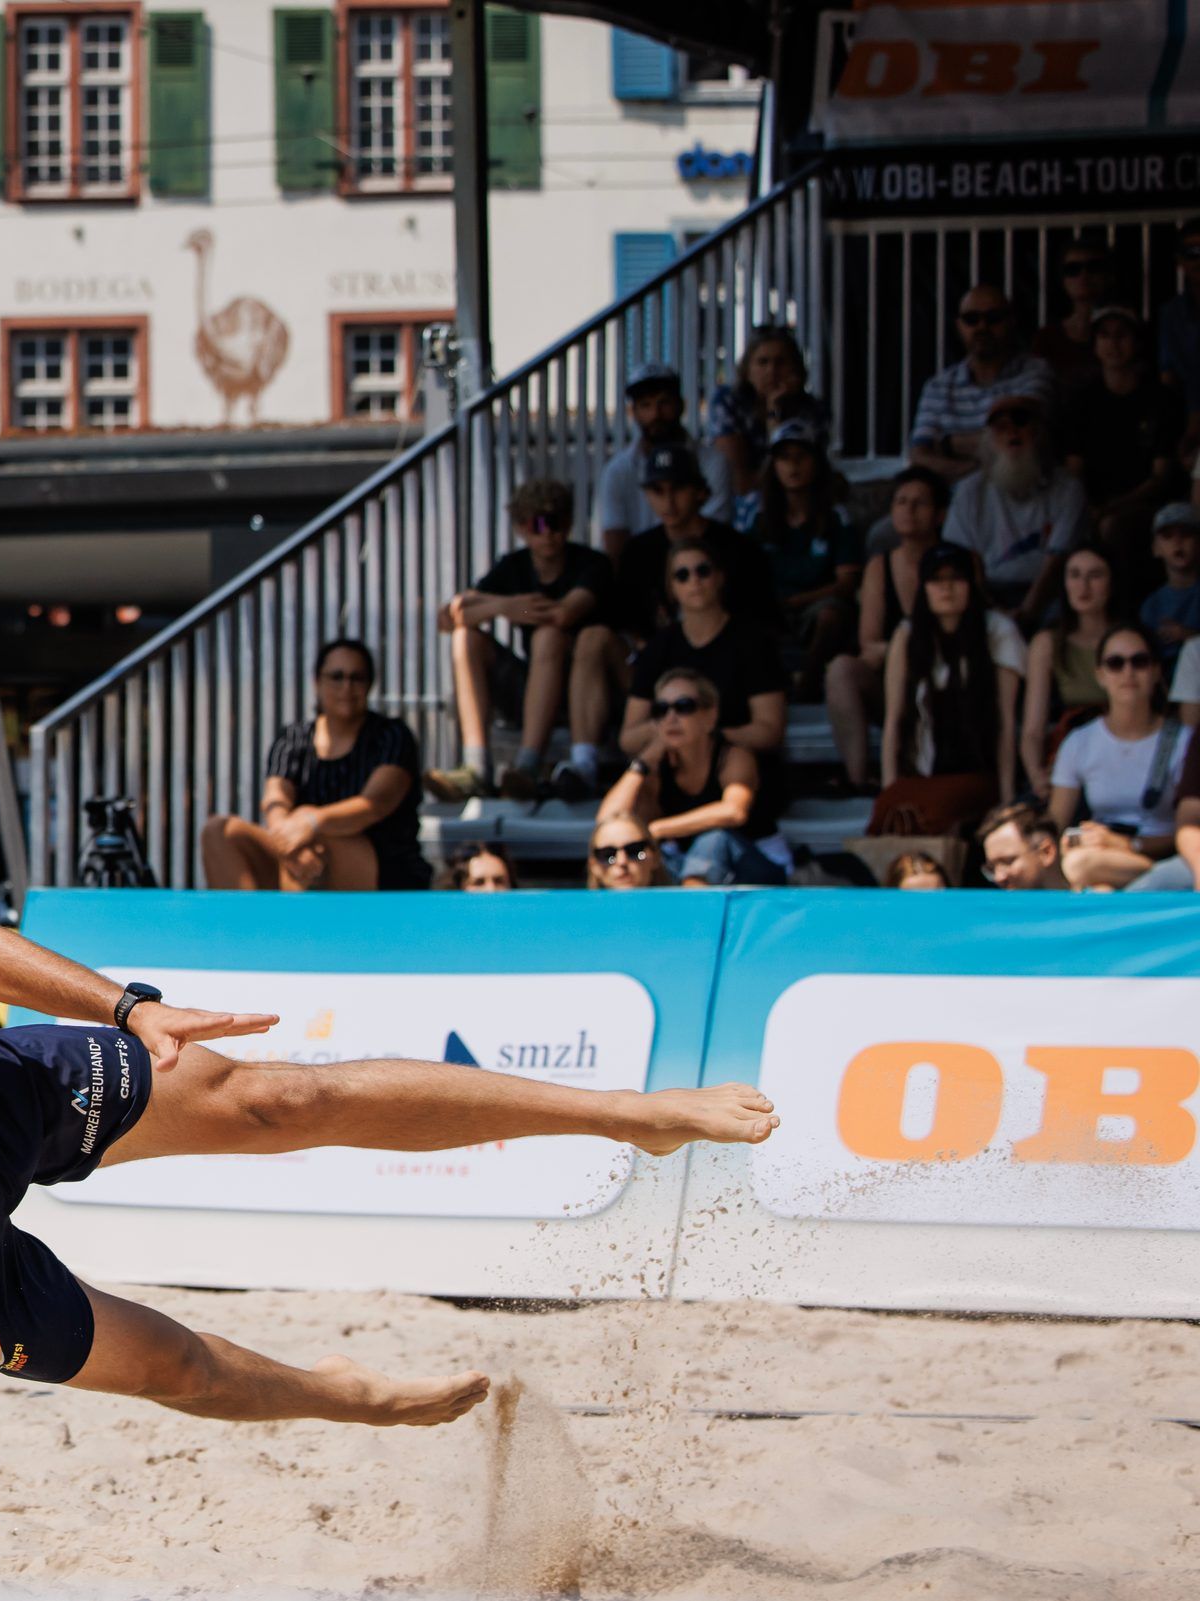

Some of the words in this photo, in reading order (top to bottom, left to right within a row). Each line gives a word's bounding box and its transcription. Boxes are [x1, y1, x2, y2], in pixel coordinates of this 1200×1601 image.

[835, 40, 1100, 98] OBI
[15, 276, 156, 303] BODEGA
[496, 1028, 599, 1070] smzh
[88, 1043, 104, 1109] TREUHAND
[118, 1049, 130, 1099] CRAFT
[834, 1040, 1200, 1167] OB
[80, 1109, 101, 1154] MAHRER
[377, 1164, 470, 1177] LIGHTING
